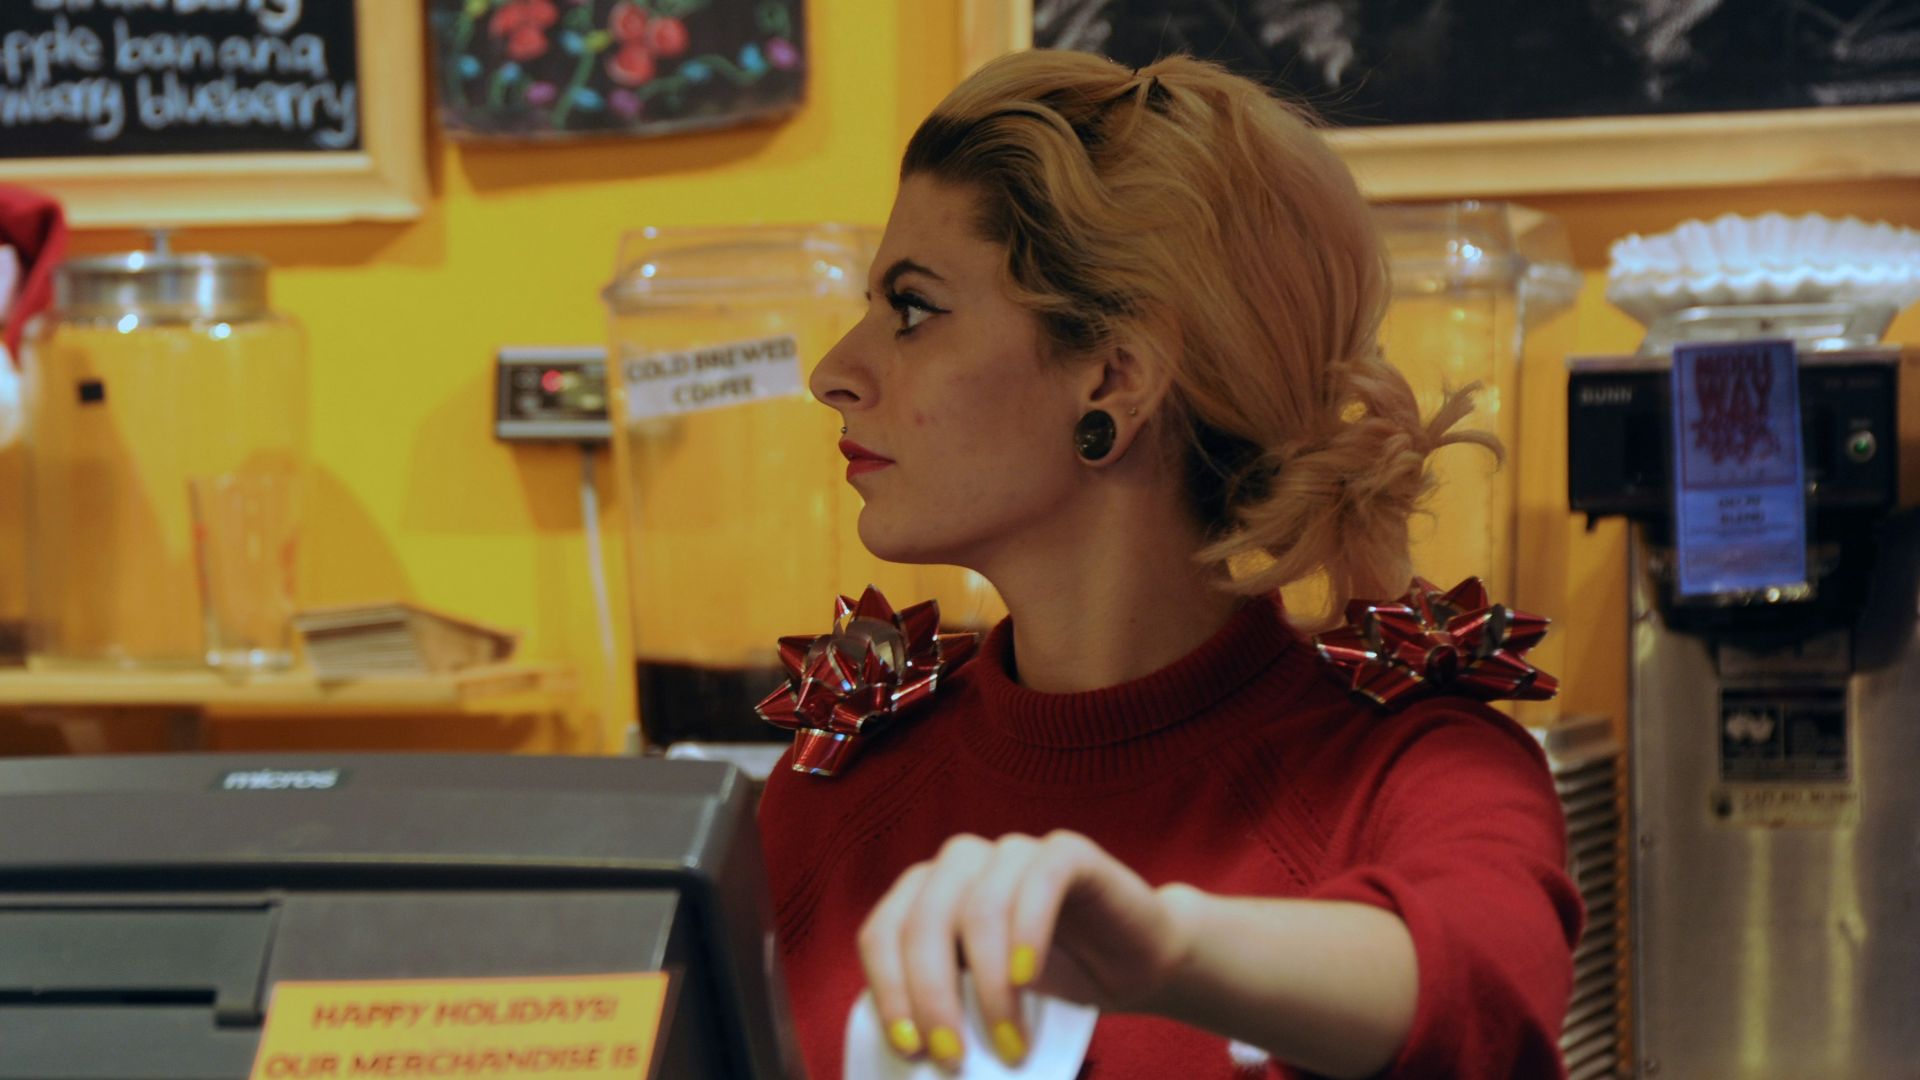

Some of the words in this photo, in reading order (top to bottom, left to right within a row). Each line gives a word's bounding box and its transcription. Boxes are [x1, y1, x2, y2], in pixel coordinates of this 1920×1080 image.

[0, 15, 101, 84] pple
[113, 18, 327, 79] banana
[137, 73, 357, 147] blueberry
[627, 354, 690, 382] COLD
[694, 335, 796, 371] BREWED
[223, 769, 339, 790] micros
[311, 1000, 430, 1030] HAPPY
[433, 995, 619, 1026] HOLIDAYS!
[265, 1053, 340, 1079] OUR
[352, 1045, 602, 1078] MERCHANDISE
[611, 1043, 639, 1068] IS
